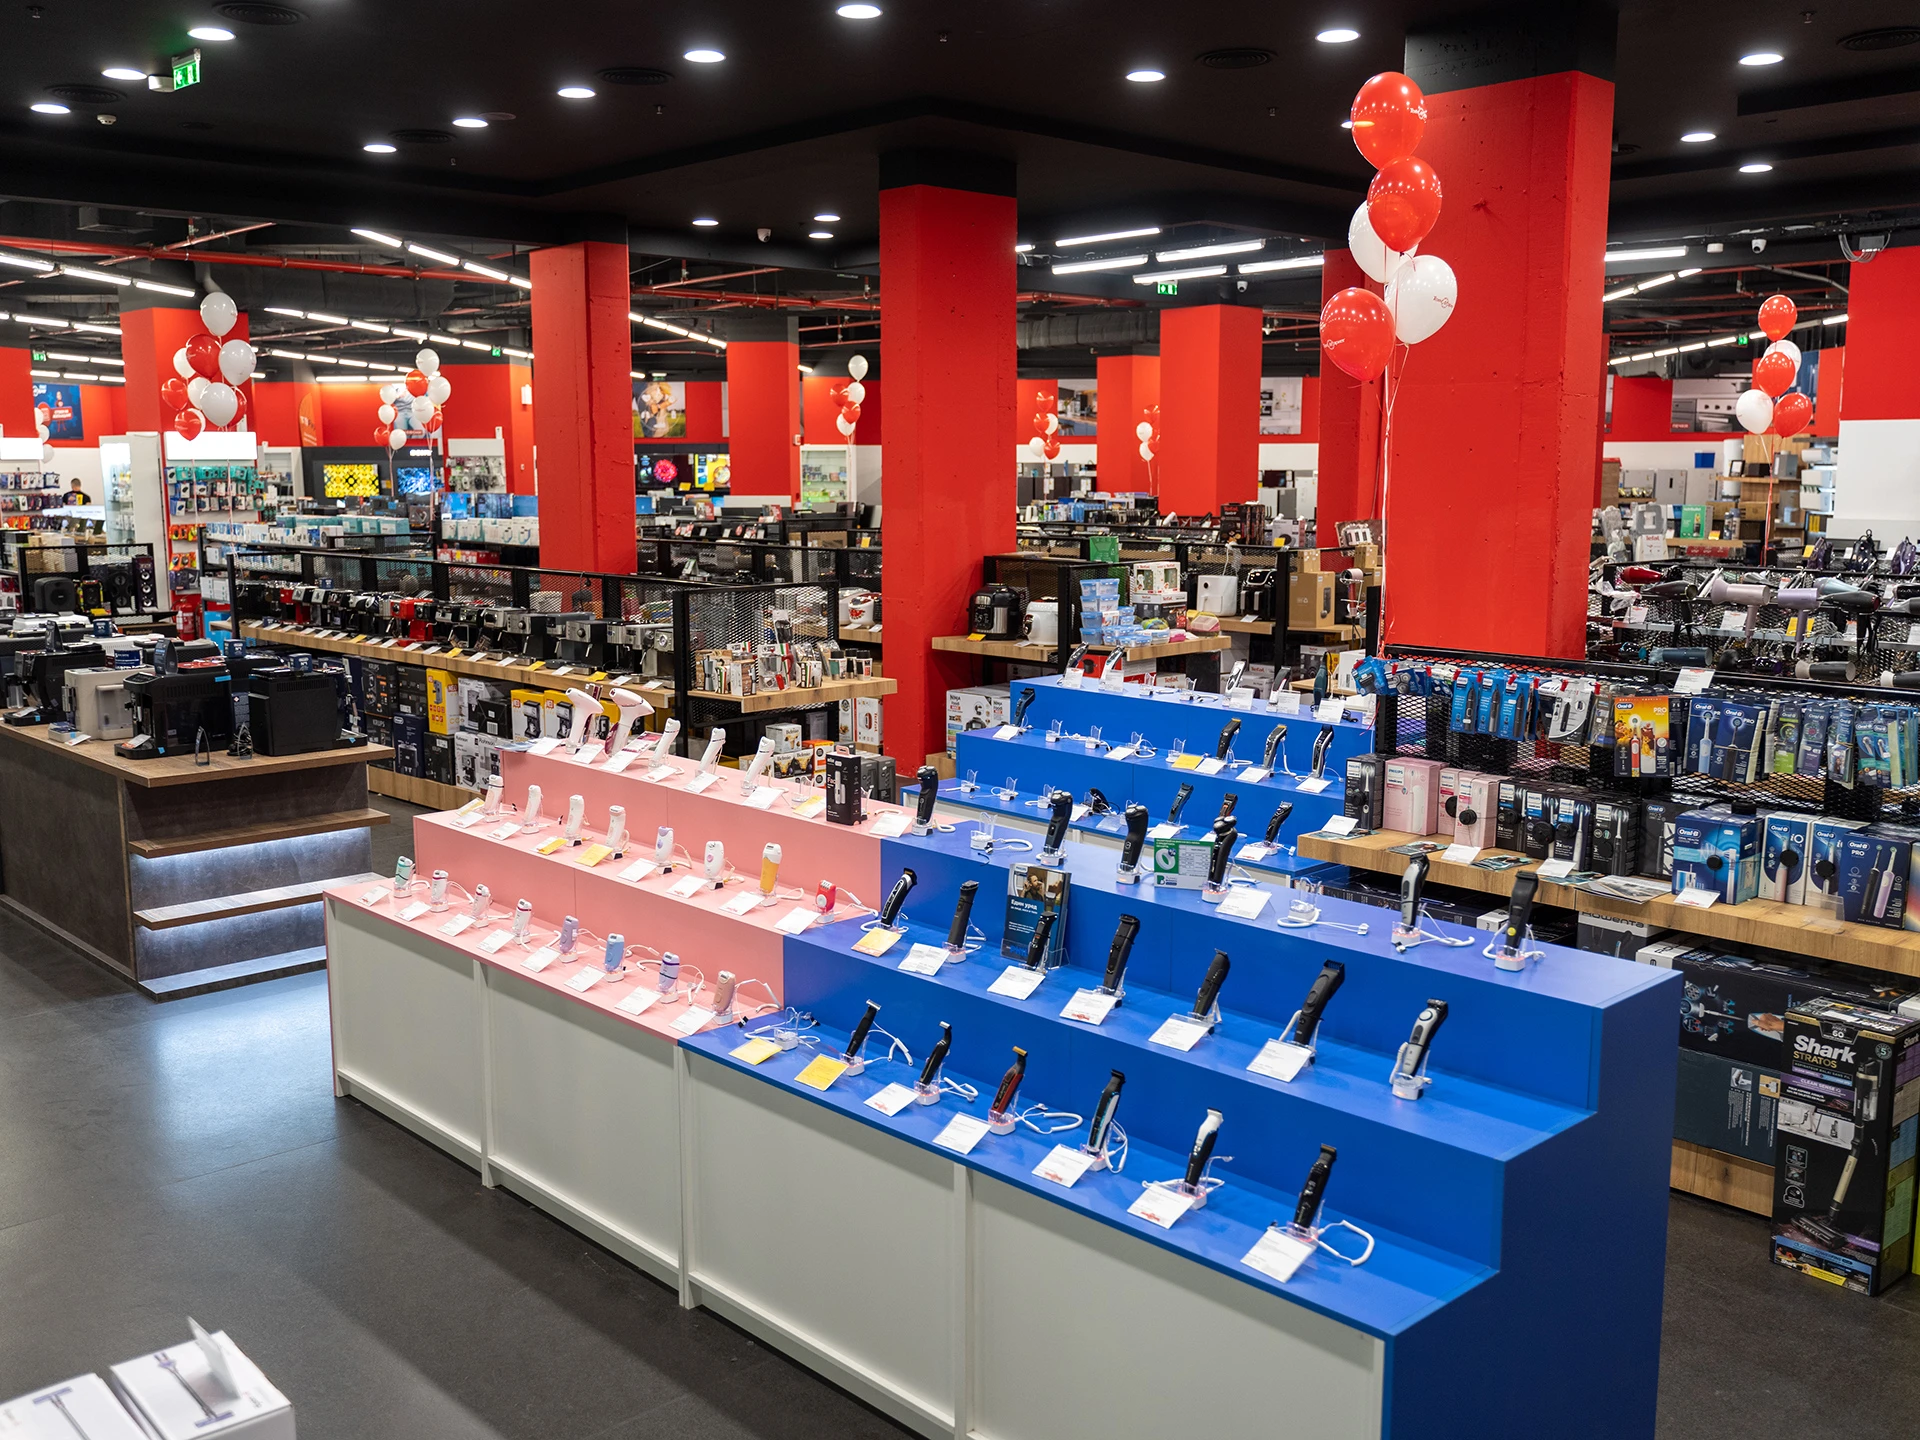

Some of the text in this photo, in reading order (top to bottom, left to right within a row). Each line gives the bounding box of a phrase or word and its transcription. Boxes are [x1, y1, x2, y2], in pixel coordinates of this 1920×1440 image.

[1679, 829, 1700, 837] Oral-B
[1849, 841, 1868, 849] Oral-B
[1010, 899, 1038, 911] Един уред
[1793, 1034, 1856, 1064] Shark
[1793, 1051, 1837, 1068] STRATOS
[1800, 1078, 1818, 1087] CLEAN
[1780, 1257, 1798, 1268] Shark
